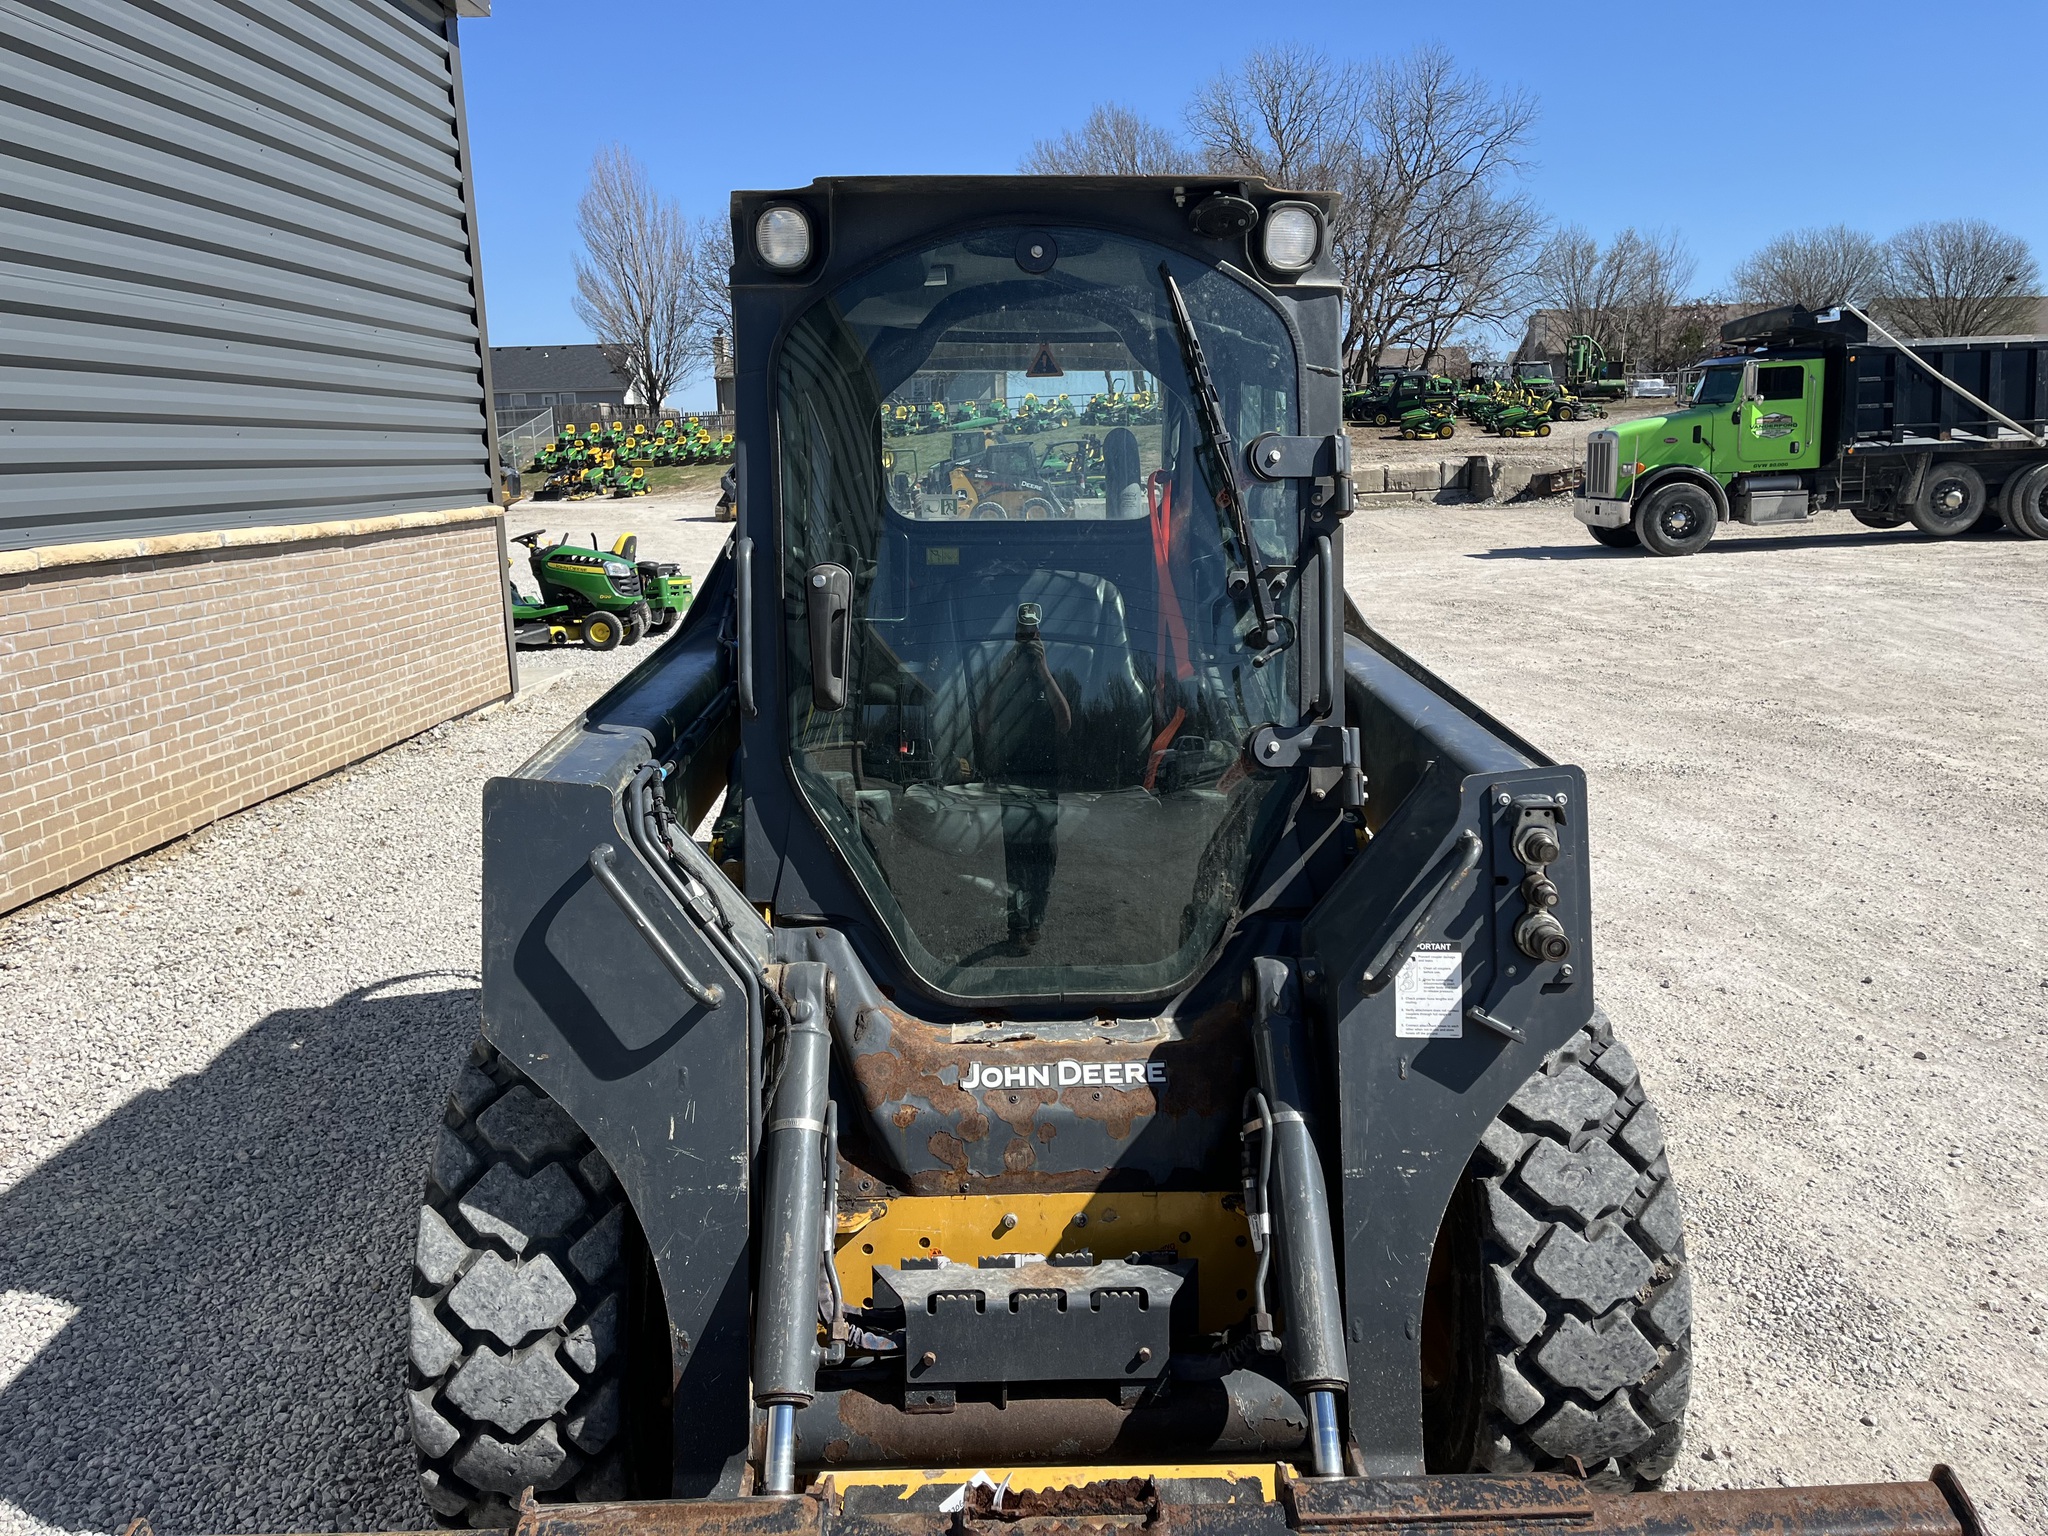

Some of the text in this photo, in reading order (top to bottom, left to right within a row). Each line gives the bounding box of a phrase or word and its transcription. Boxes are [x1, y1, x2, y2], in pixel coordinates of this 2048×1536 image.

[1021, 481, 1043, 491] DEERE
[962, 1061, 1167, 1089] JOHN DEERE
